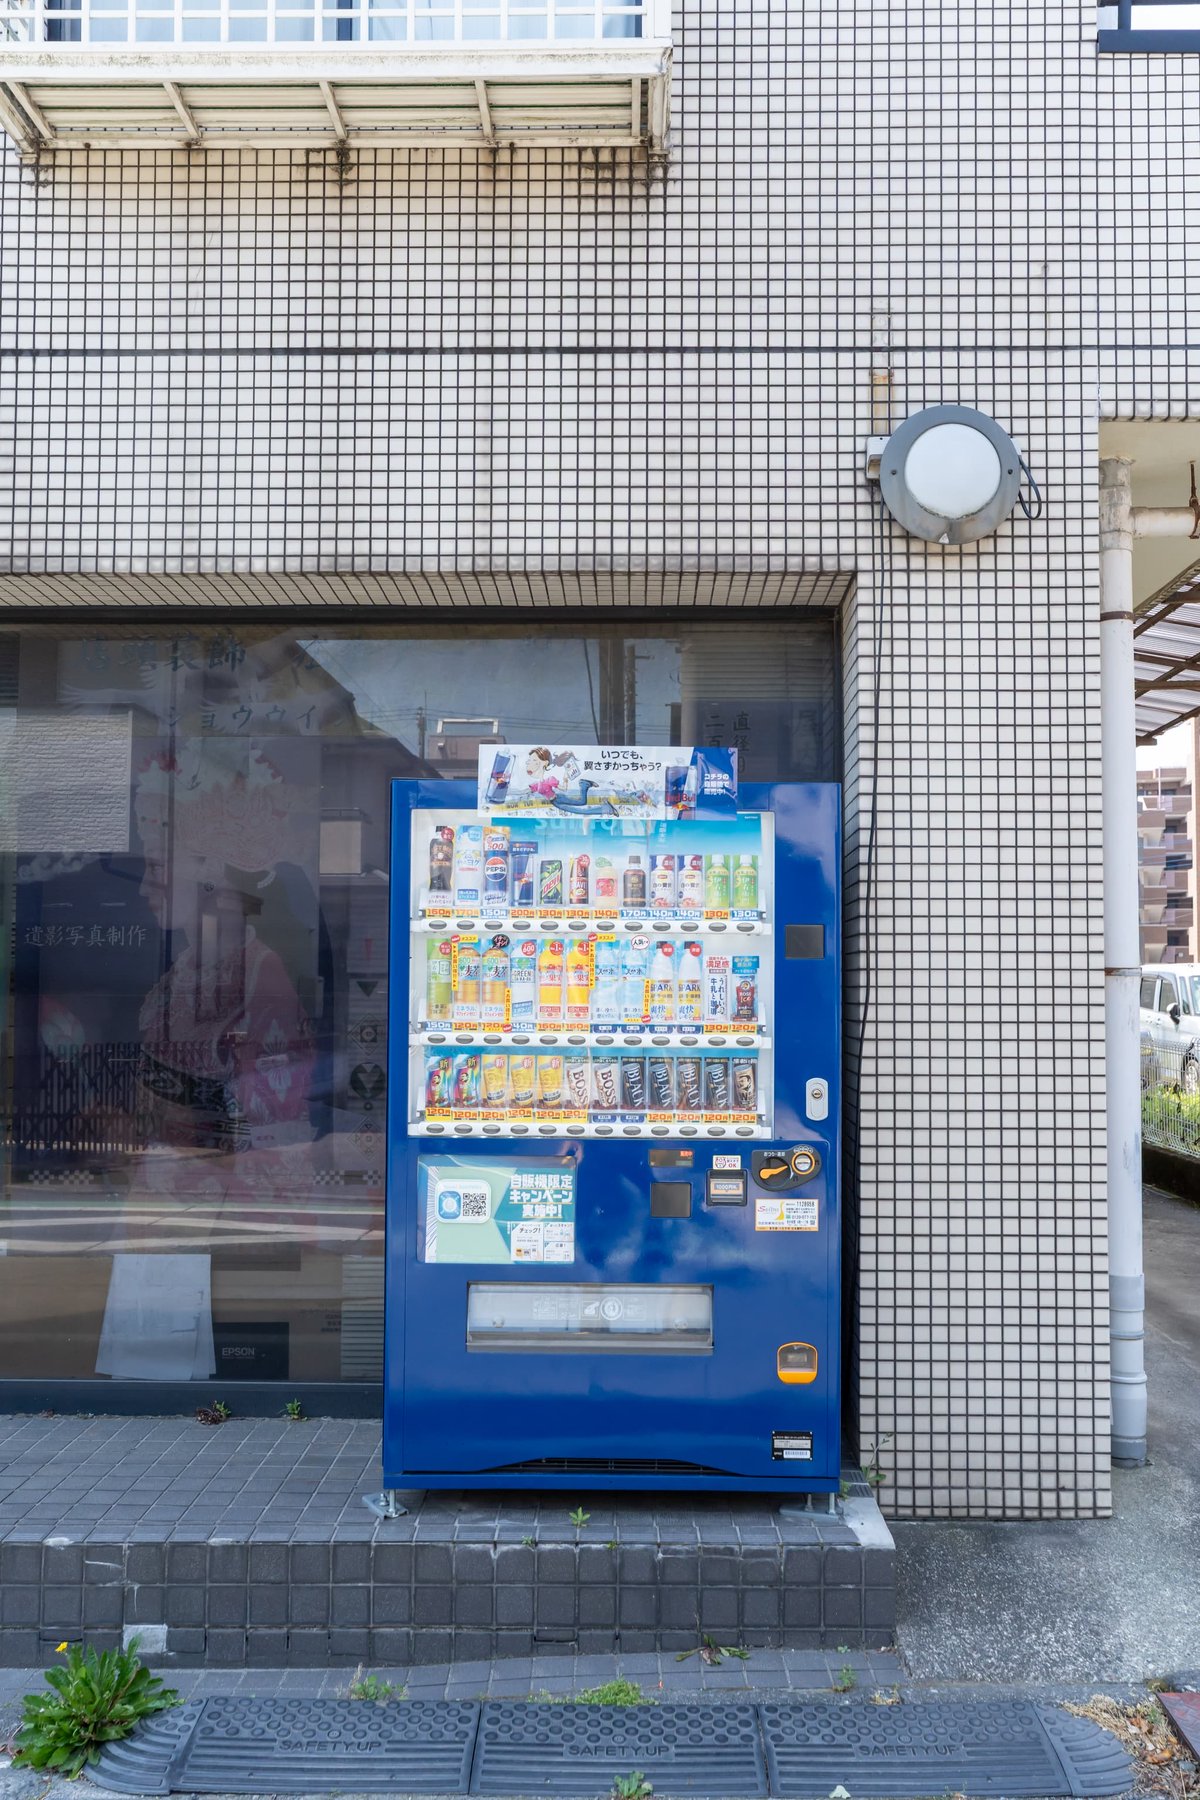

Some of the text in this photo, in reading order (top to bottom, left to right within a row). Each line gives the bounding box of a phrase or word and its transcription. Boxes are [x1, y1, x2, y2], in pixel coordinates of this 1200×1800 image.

[601, 750, 643, 759] いつでも、
[24, 926, 149, 948] 遺影写真制作
[601, 1070, 617, 1105] BOSS
[626, 1067, 644, 1107] BLACK
[655, 1067, 673, 1107] BLACK
[683, 1067, 701, 1107] BLACK
[711, 1067, 729, 1107] BLACK
[509, 1189, 573, 1203] キャンペーン
[222, 1347, 255, 1356] EPSON
